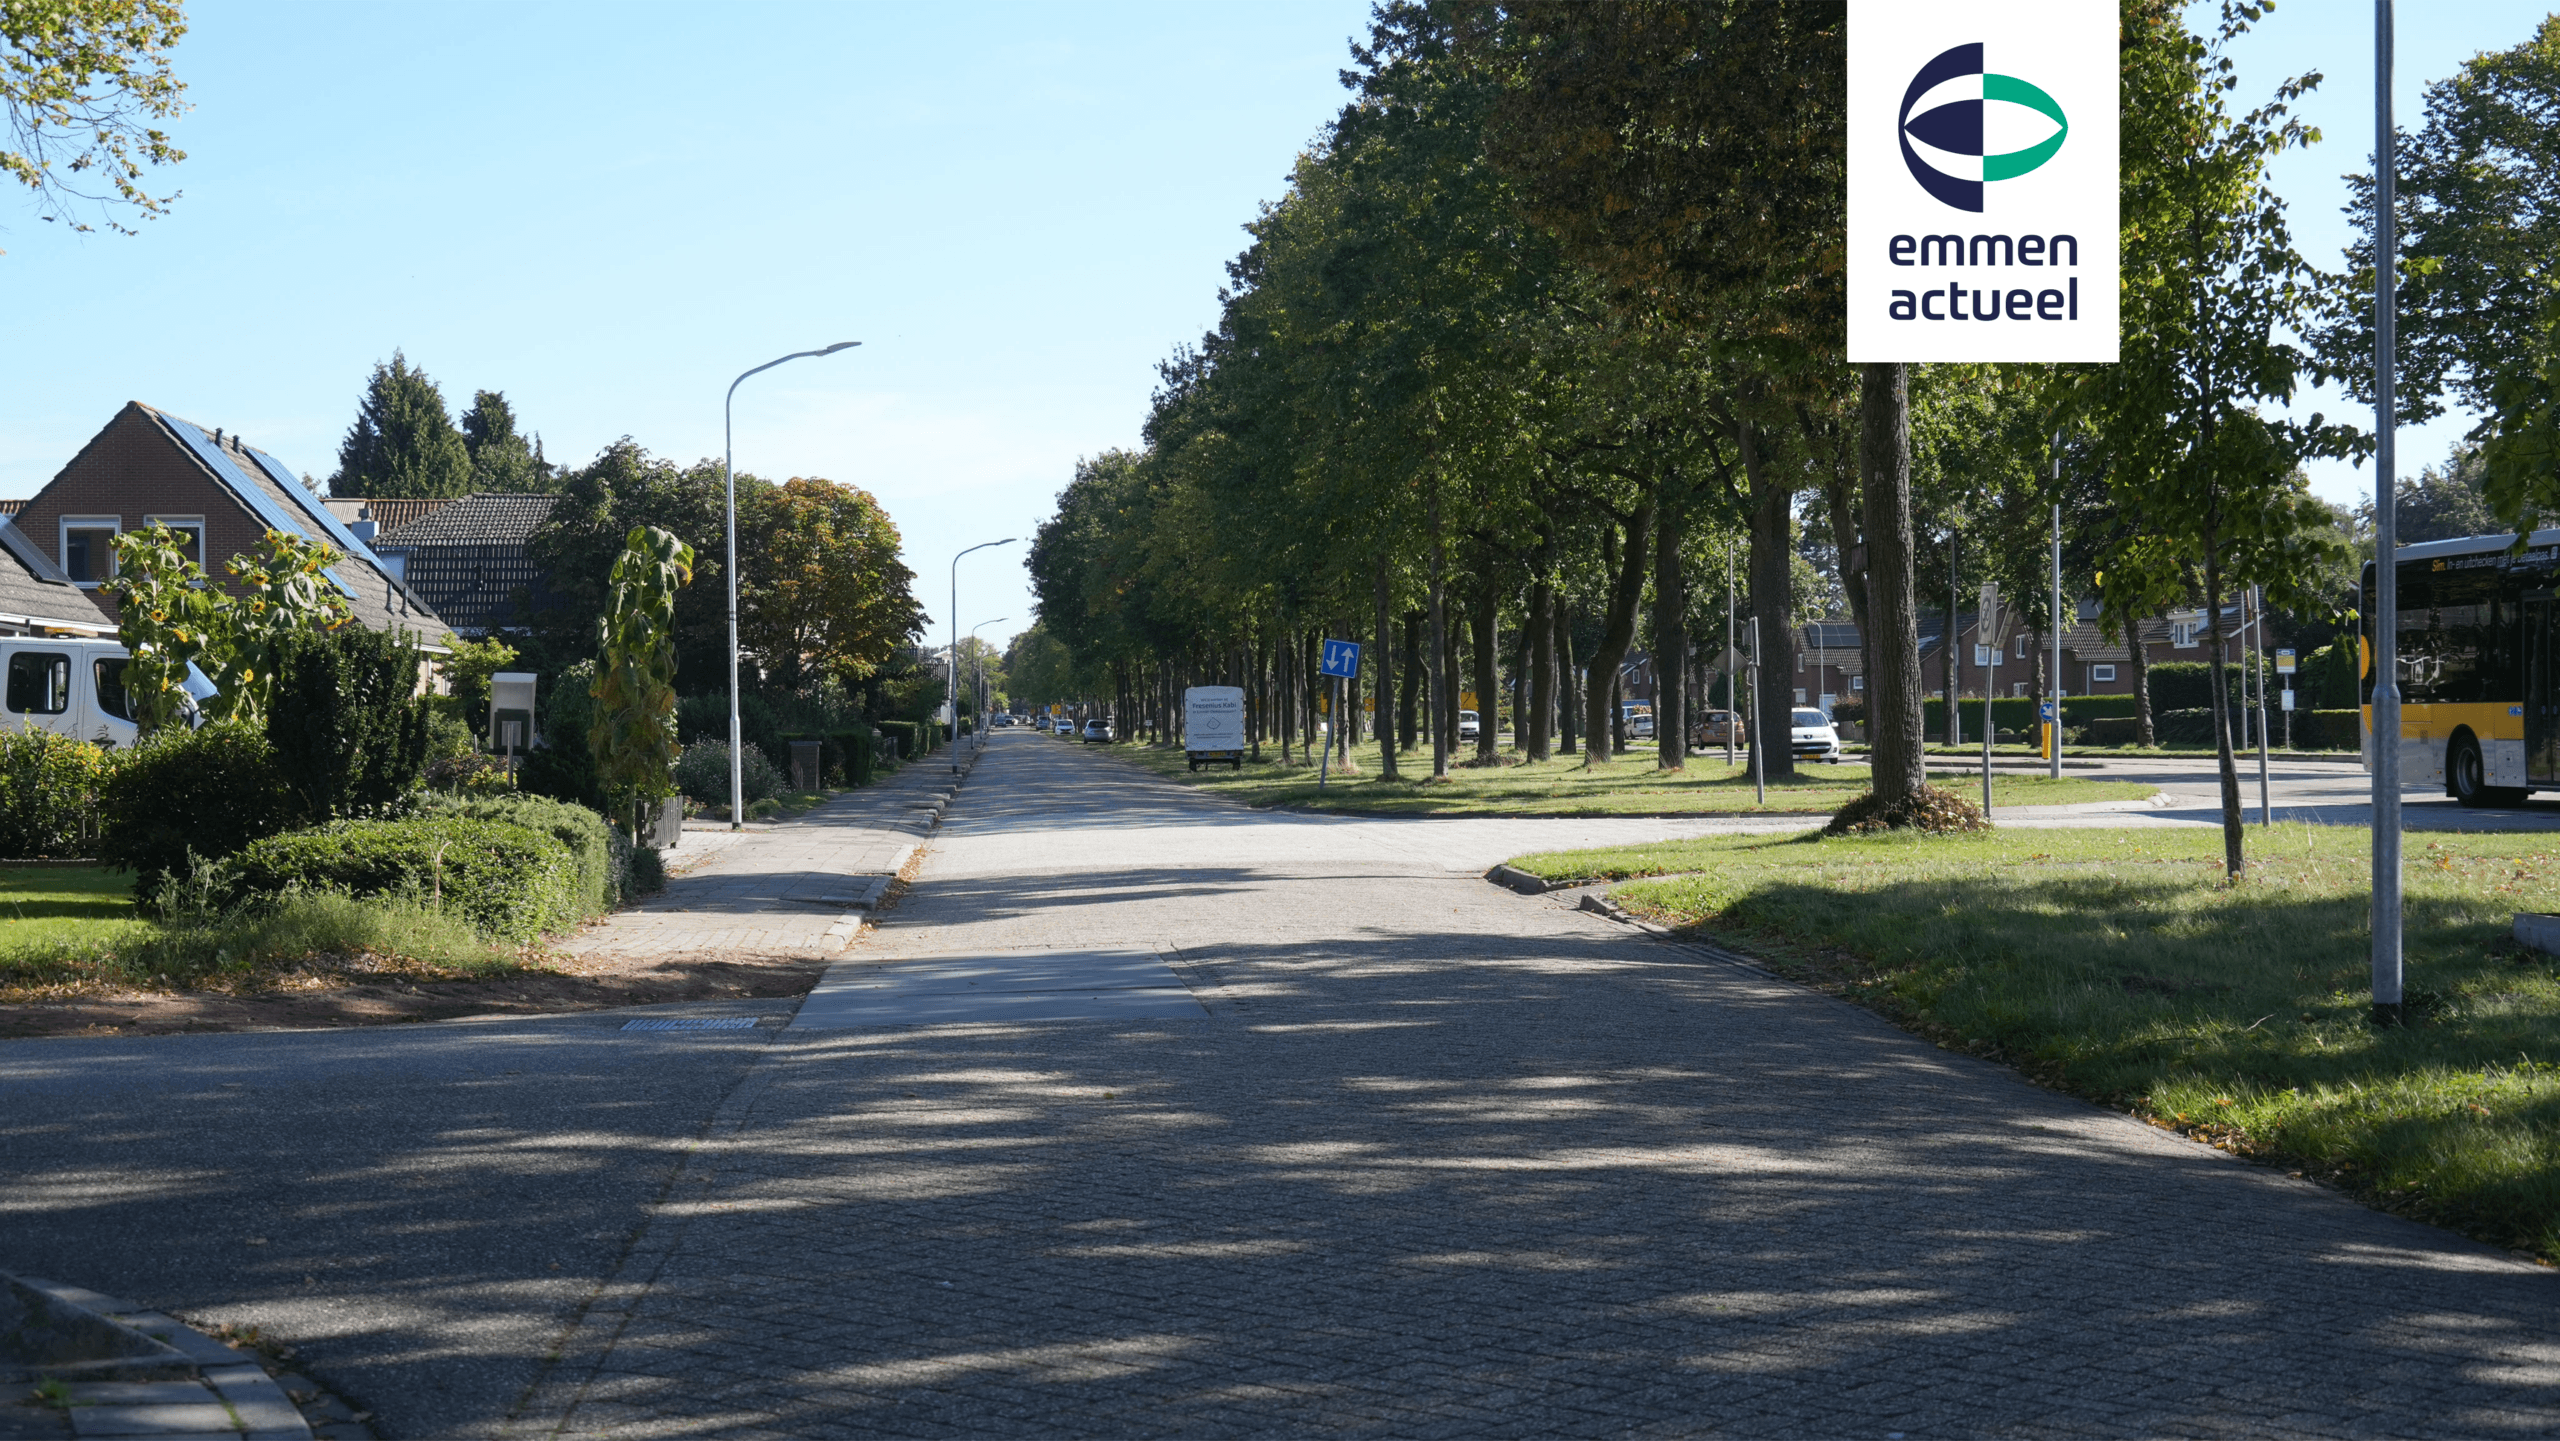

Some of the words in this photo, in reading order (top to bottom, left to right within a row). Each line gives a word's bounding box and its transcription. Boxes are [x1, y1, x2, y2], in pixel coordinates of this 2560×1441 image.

[2456, 560, 2464, 570] en
[2464, 554, 2497, 569] uitchecken
[2497, 552, 2510, 566] met
[1222, 701, 1237, 709] Kabi
